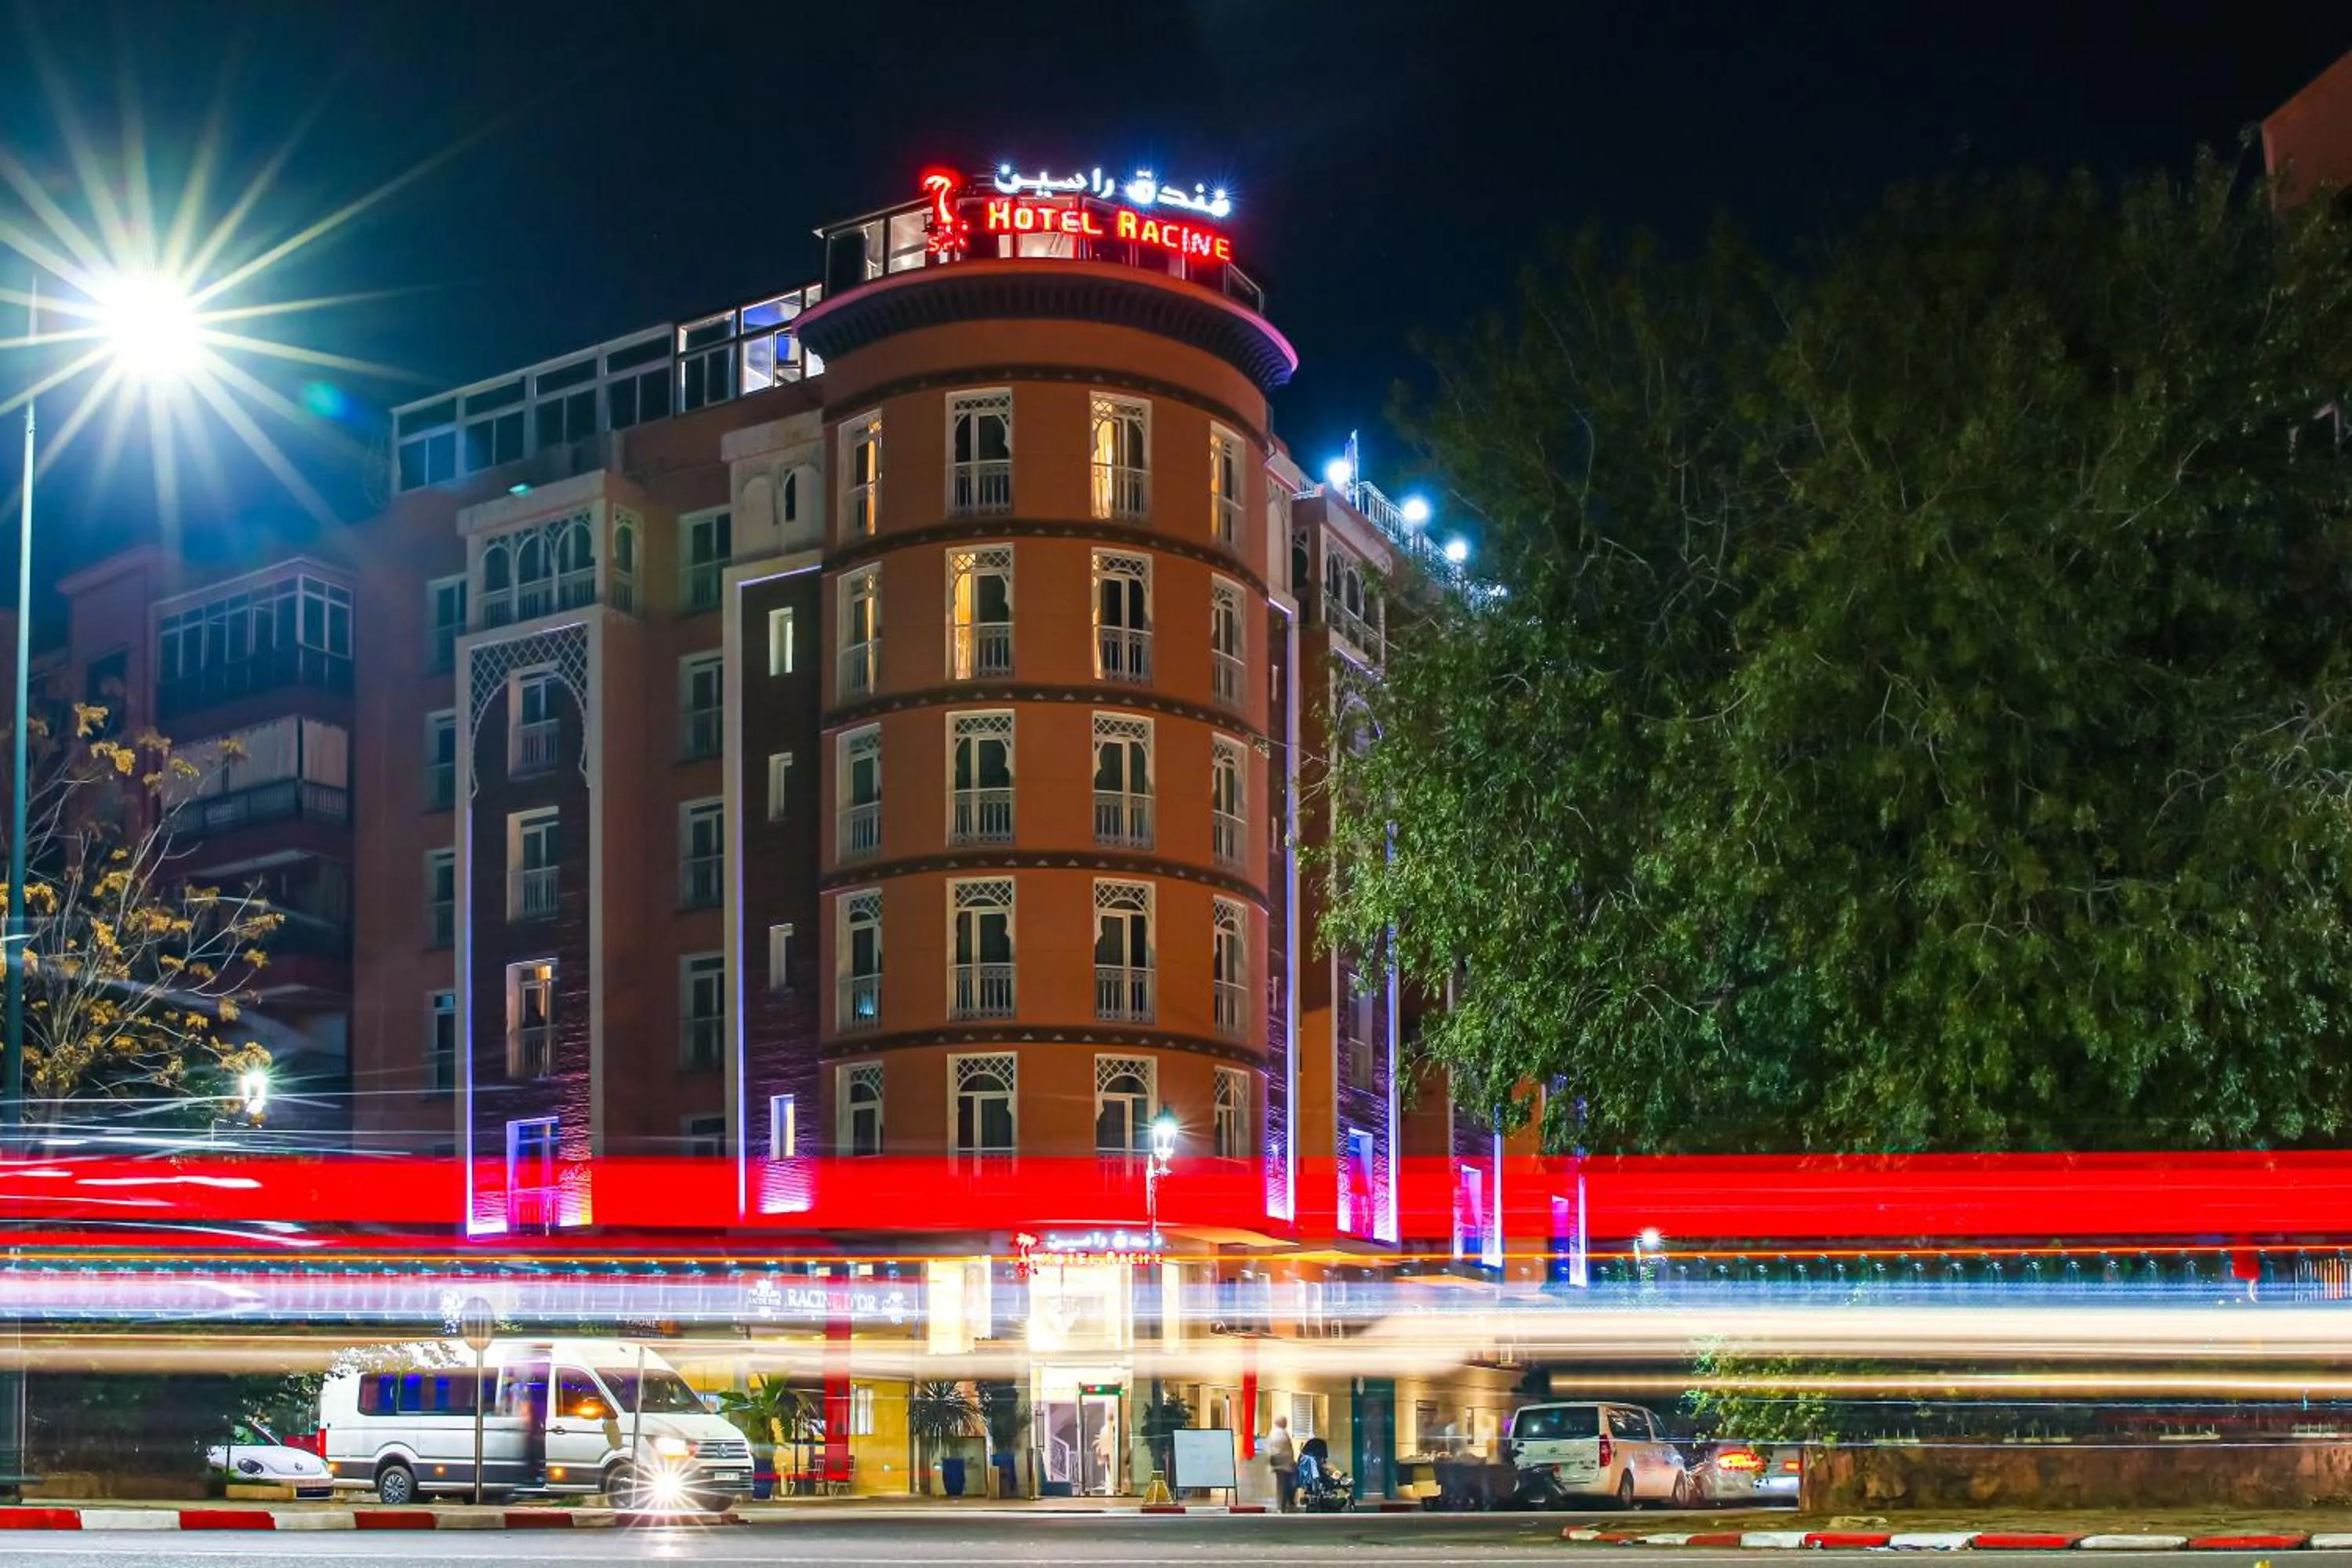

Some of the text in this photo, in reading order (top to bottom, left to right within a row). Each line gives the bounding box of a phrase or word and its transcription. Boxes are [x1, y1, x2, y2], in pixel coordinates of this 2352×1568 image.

[994, 164, 1231, 217] فندق راسين
[988, 201, 1231, 261] HOTEL RACINE
